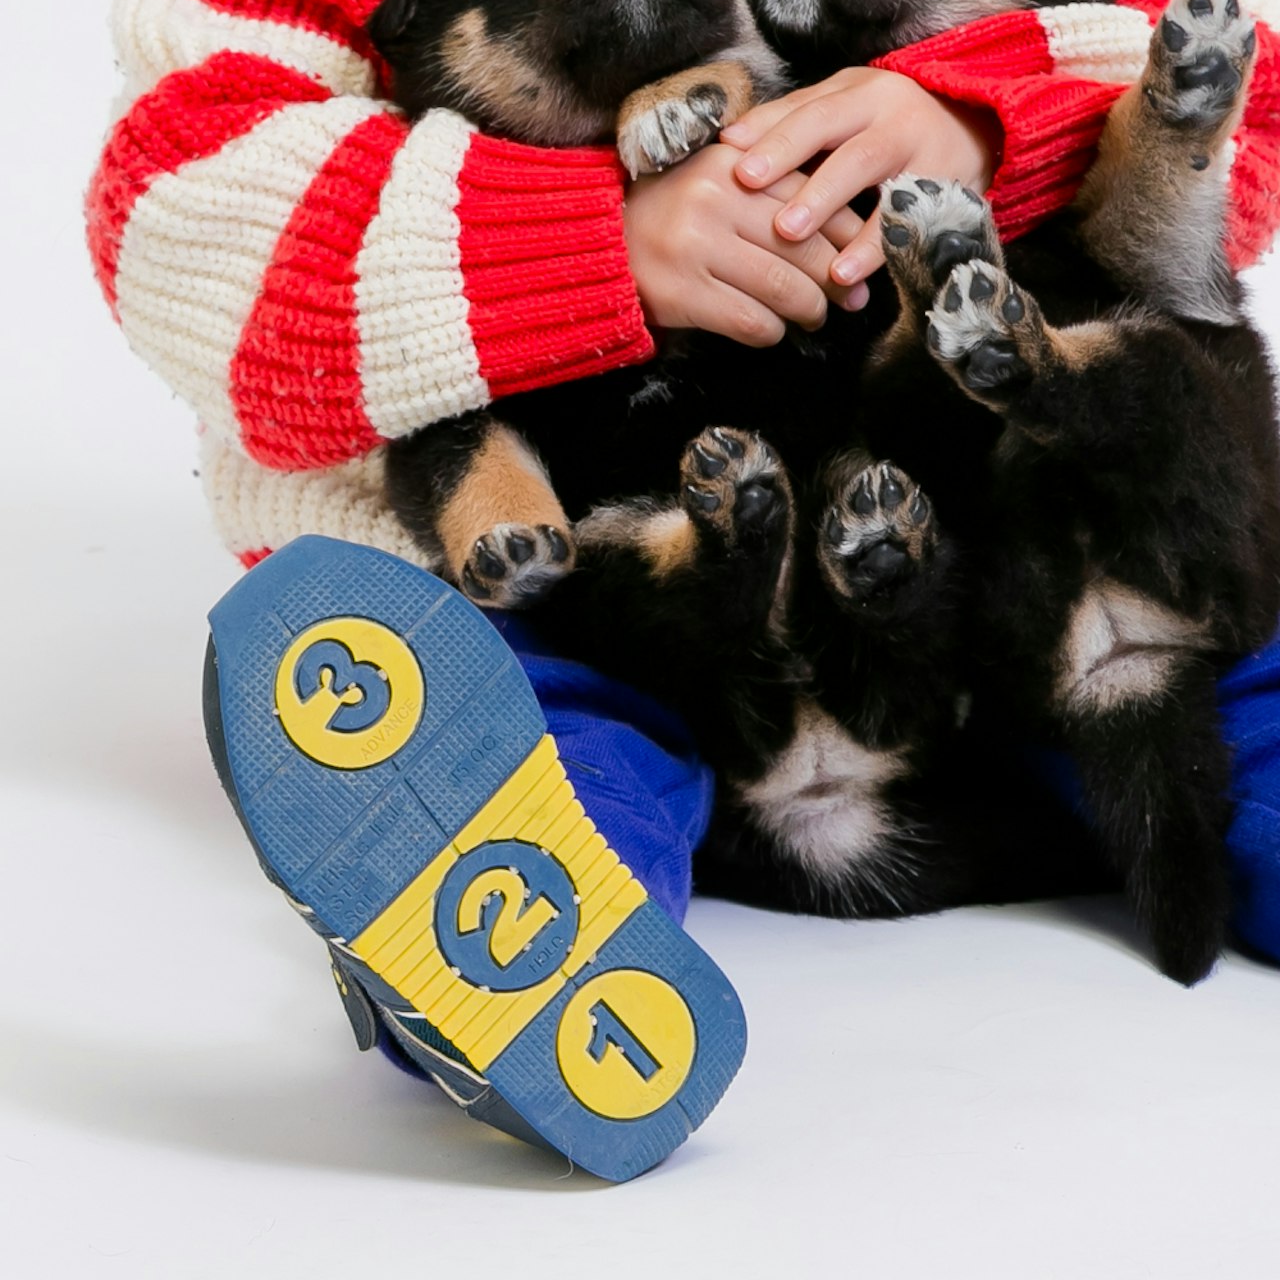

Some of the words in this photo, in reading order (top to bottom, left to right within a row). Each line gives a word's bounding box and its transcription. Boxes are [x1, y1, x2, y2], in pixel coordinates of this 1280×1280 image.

[293, 637, 392, 734] 3
[360, 697, 418, 760] ADVANCE
[457, 865, 563, 970] 2
[586, 998, 663, 1082] 1
